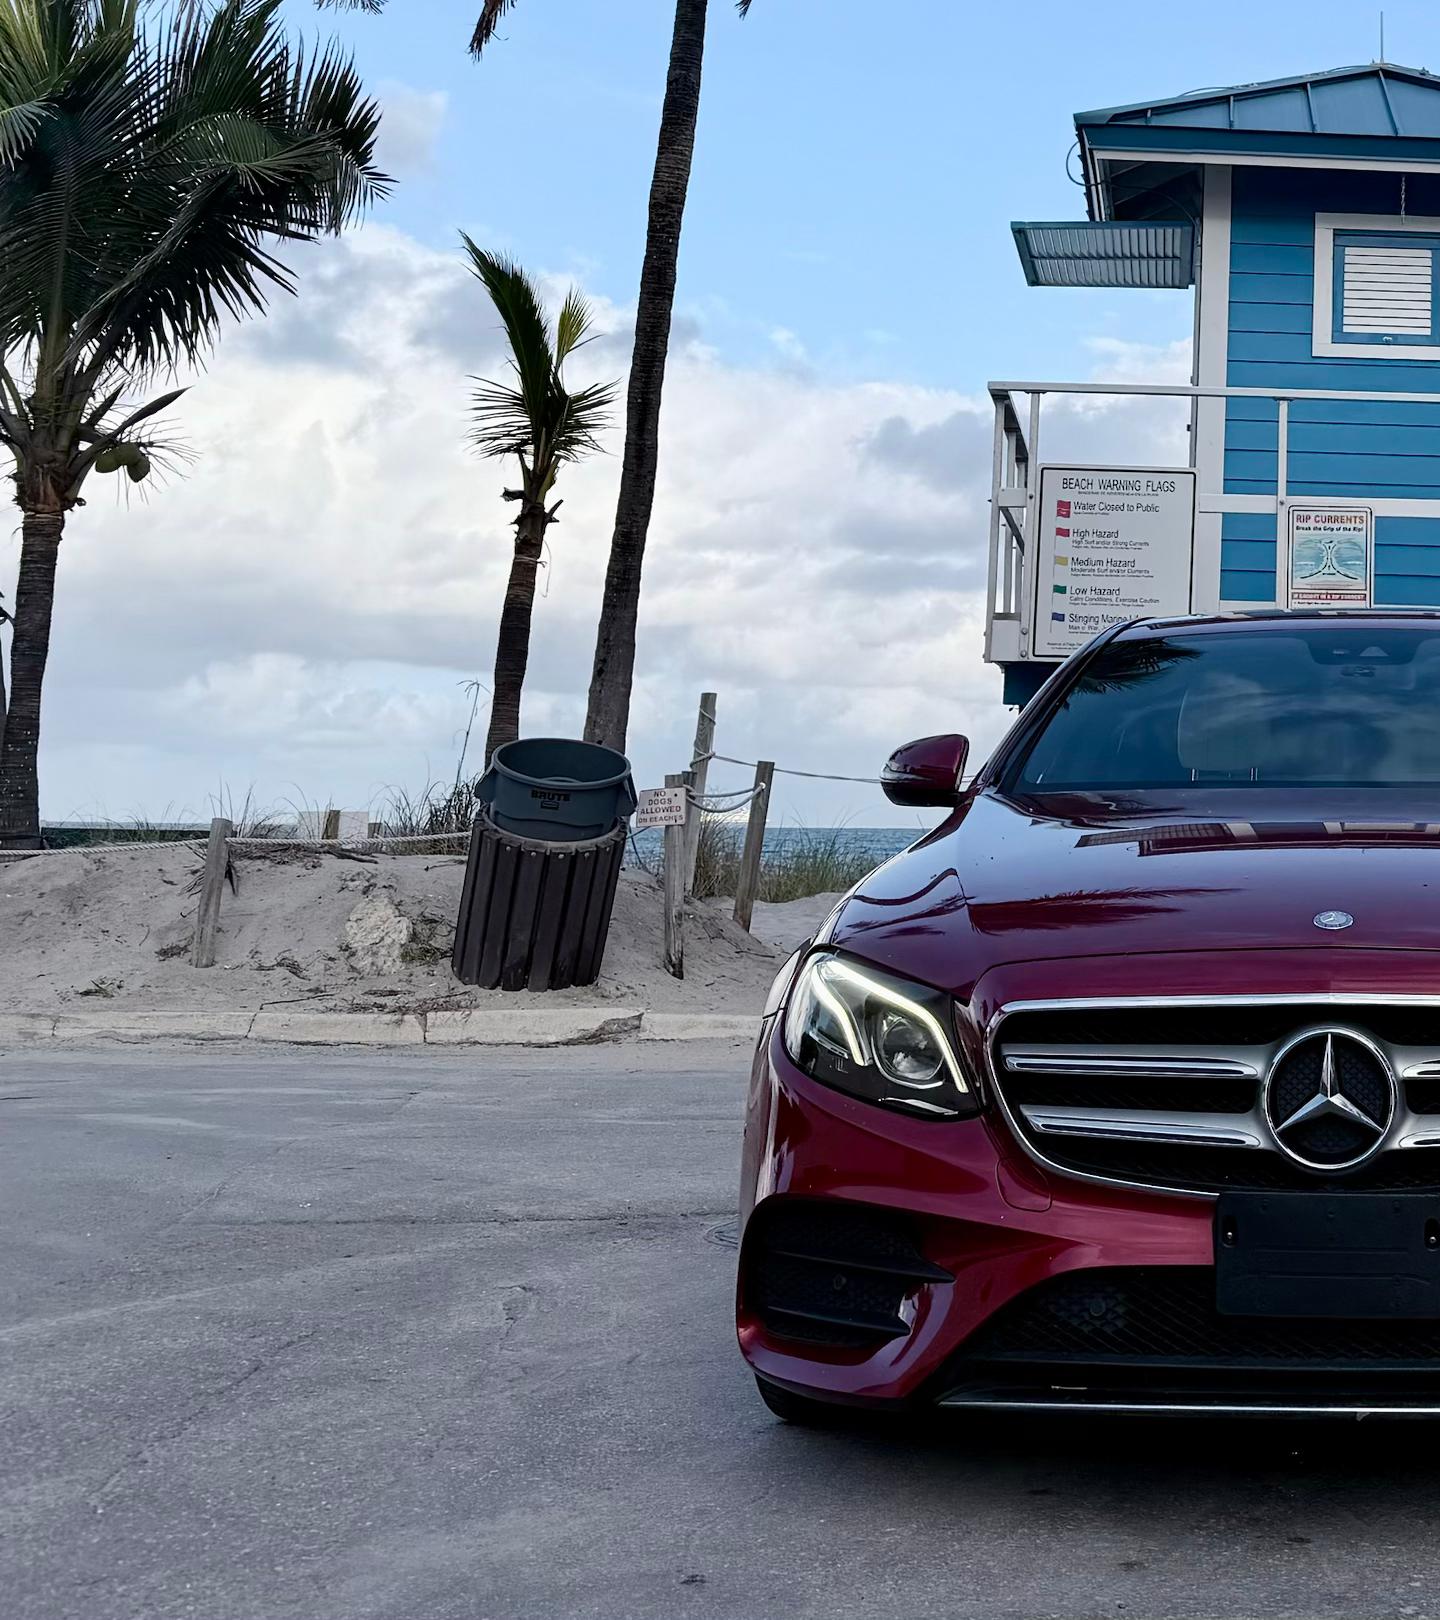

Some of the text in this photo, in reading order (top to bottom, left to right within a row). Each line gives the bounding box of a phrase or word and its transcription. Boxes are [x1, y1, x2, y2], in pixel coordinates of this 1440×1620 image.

[1062, 478, 1176, 492] BEACH WARNING FLAGS
[1074, 502, 1160, 512] Water Closed to Public
[1296, 514, 1365, 524] RIP CURRENTS
[1072, 528, 1119, 539] High Hazard
[1071, 557, 1136, 568] Medium Hazard
[1070, 586, 1120, 596] Low Hazard
[1068, 613, 1099, 625] Stinging
[531, 790, 570, 801] BRUTE
[640, 806, 681, 815] ALLOWED
